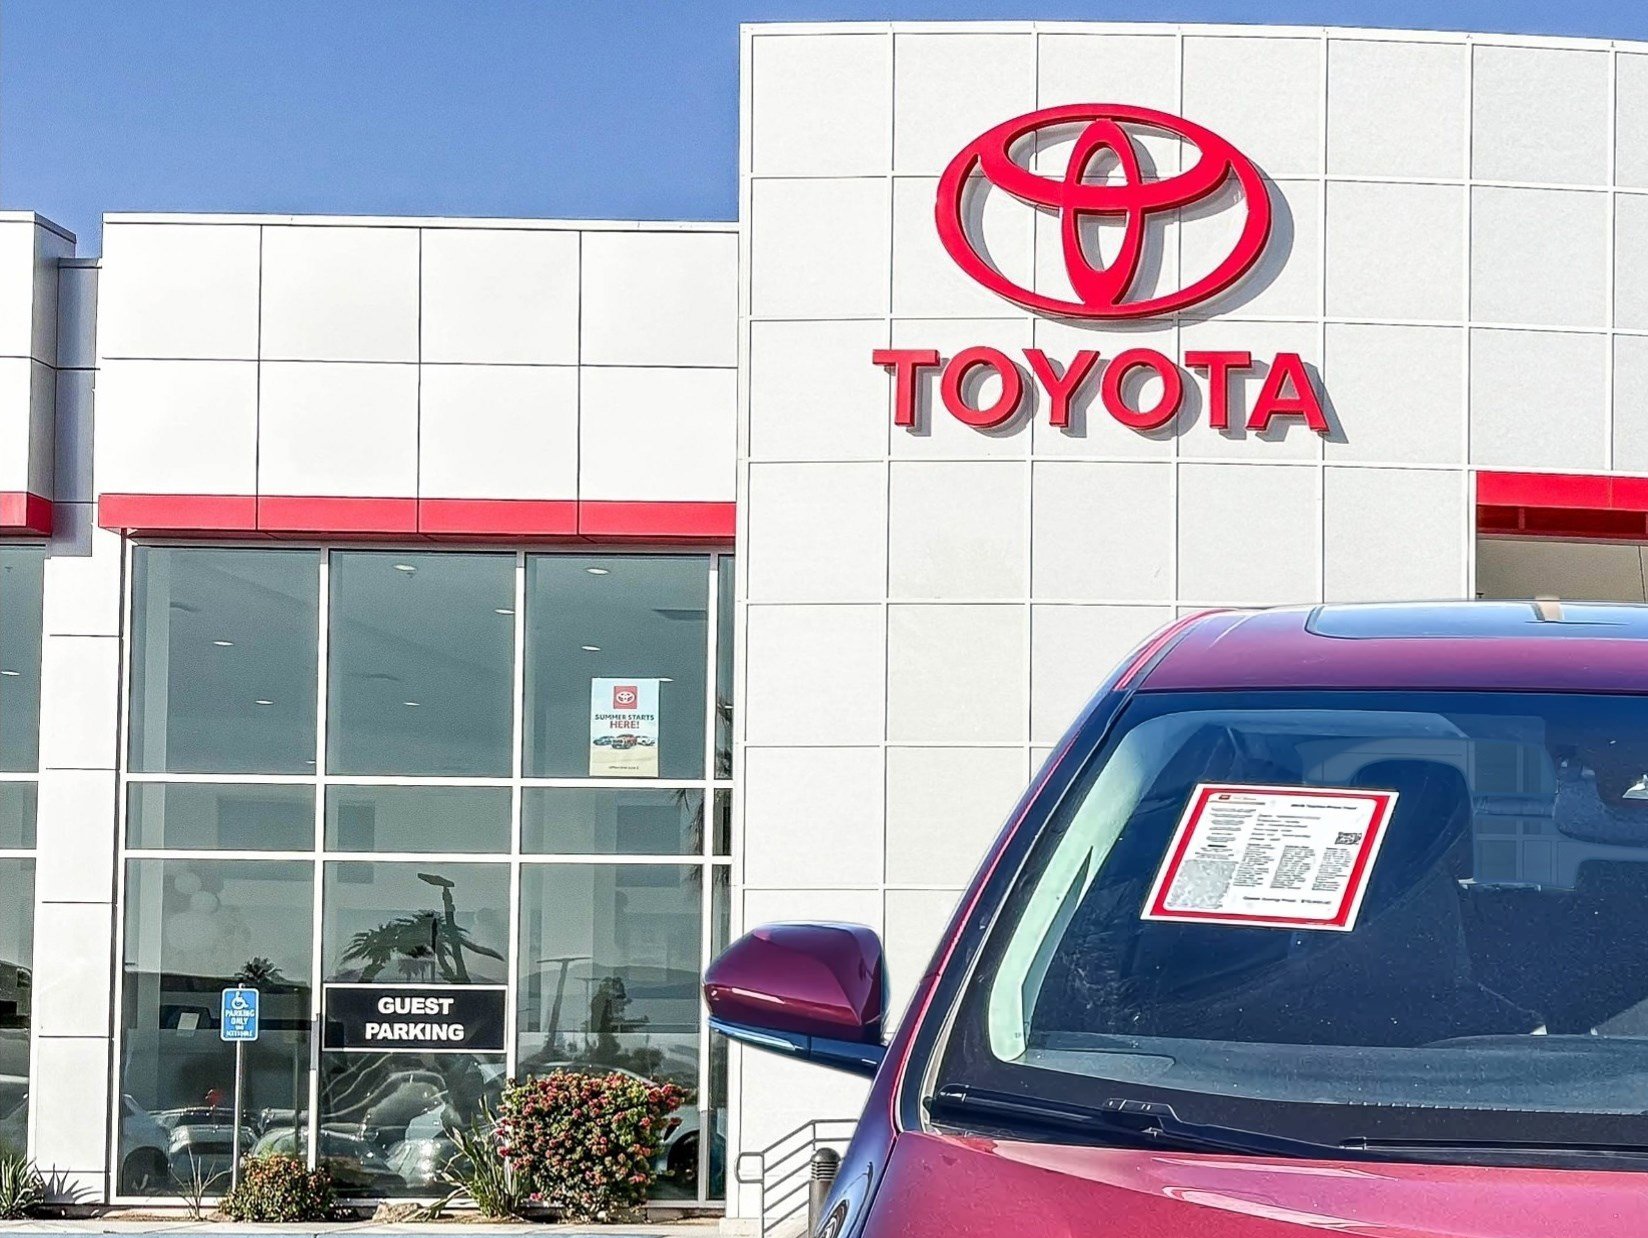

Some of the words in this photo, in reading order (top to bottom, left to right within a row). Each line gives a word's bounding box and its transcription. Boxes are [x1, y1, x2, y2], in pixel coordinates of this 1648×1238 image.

[872, 346, 1330, 432] TOYOTA
[609, 720, 640, 729] HERE!
[226, 1009, 256, 1018] PARKING
[377, 996, 455, 1015] GUEST
[365, 1022, 465, 1041] PARKING
